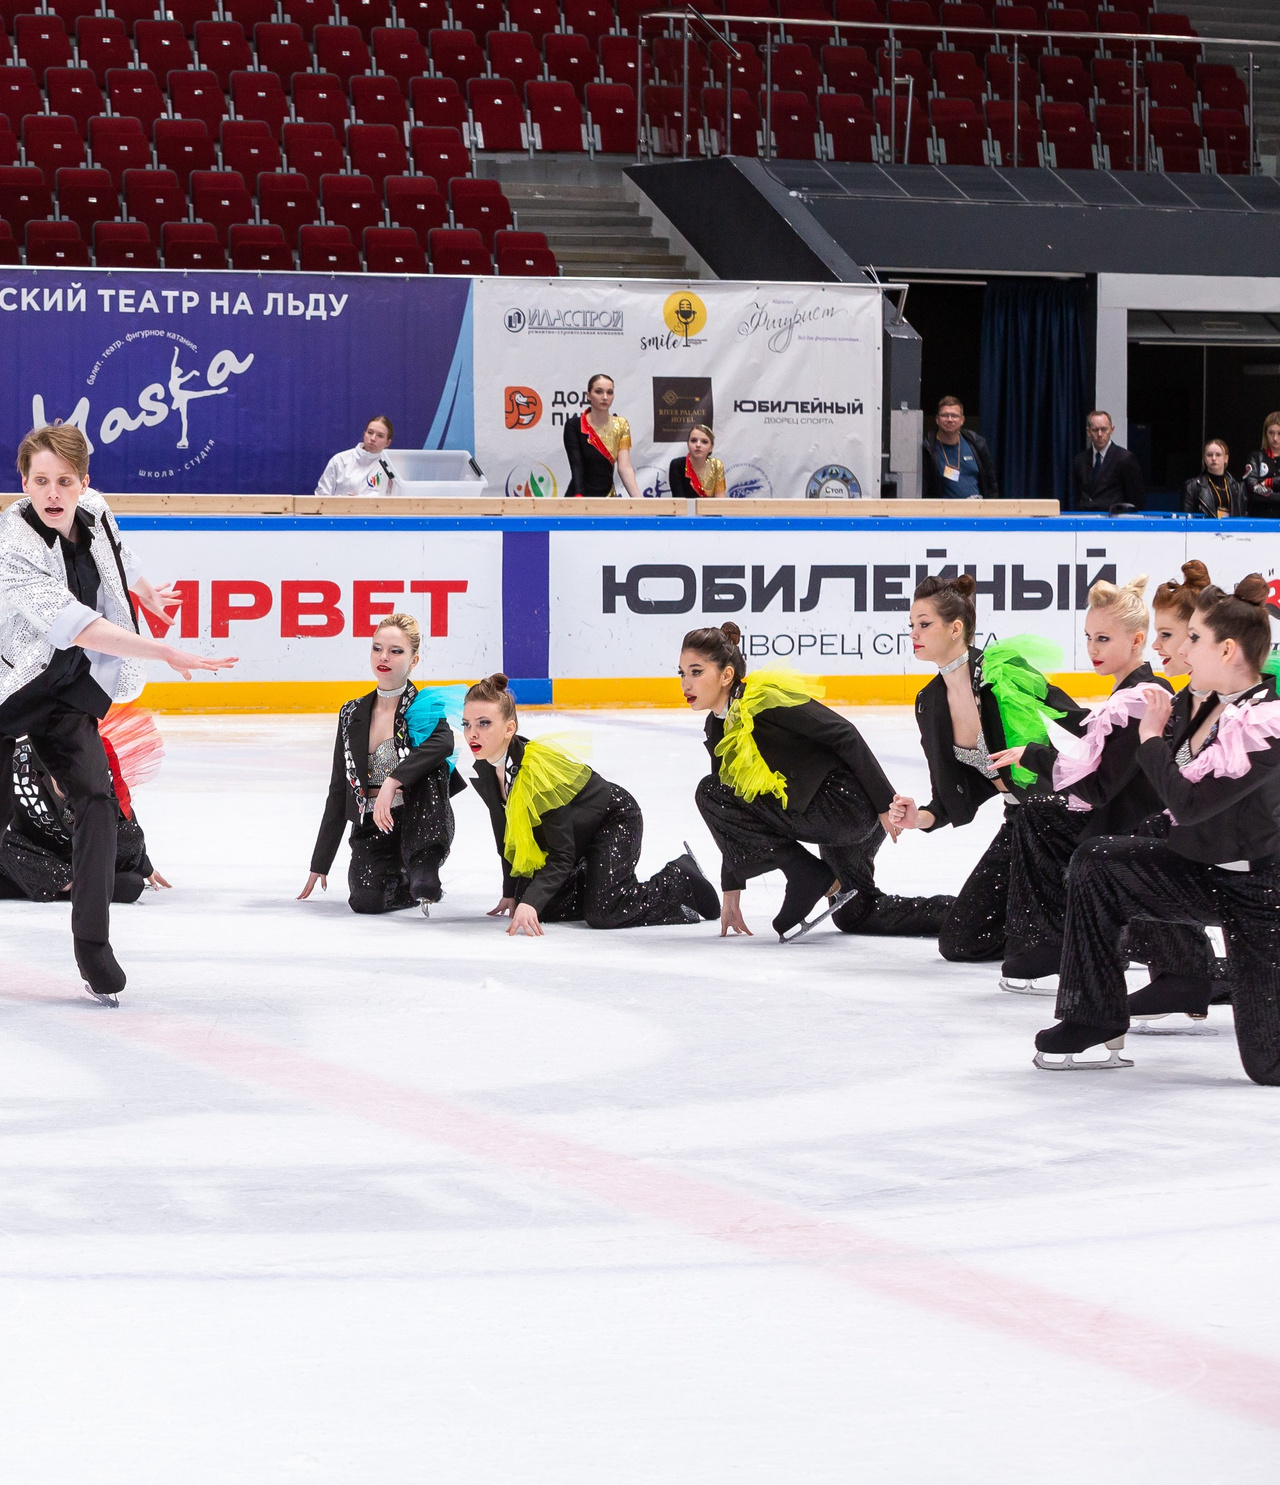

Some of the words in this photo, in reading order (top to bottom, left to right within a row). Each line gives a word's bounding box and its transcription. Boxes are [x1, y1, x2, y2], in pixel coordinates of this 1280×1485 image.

[97, 289, 200, 313] ТЕАТР
[210, 291, 254, 315] НА
[263, 292, 349, 320] ЛЬДУ
[125, 329, 165, 343] фигурное
[552, 391, 591, 407] ДОД
[733, 397, 864, 415] ЮБИЛЕЙНЫЙ
[763, 416, 799, 425] ДВОРЕЦ
[138, 469, 175, 478] школа
[184, 438, 215, 470] студия
[825, 486, 844, 494] Стоп
